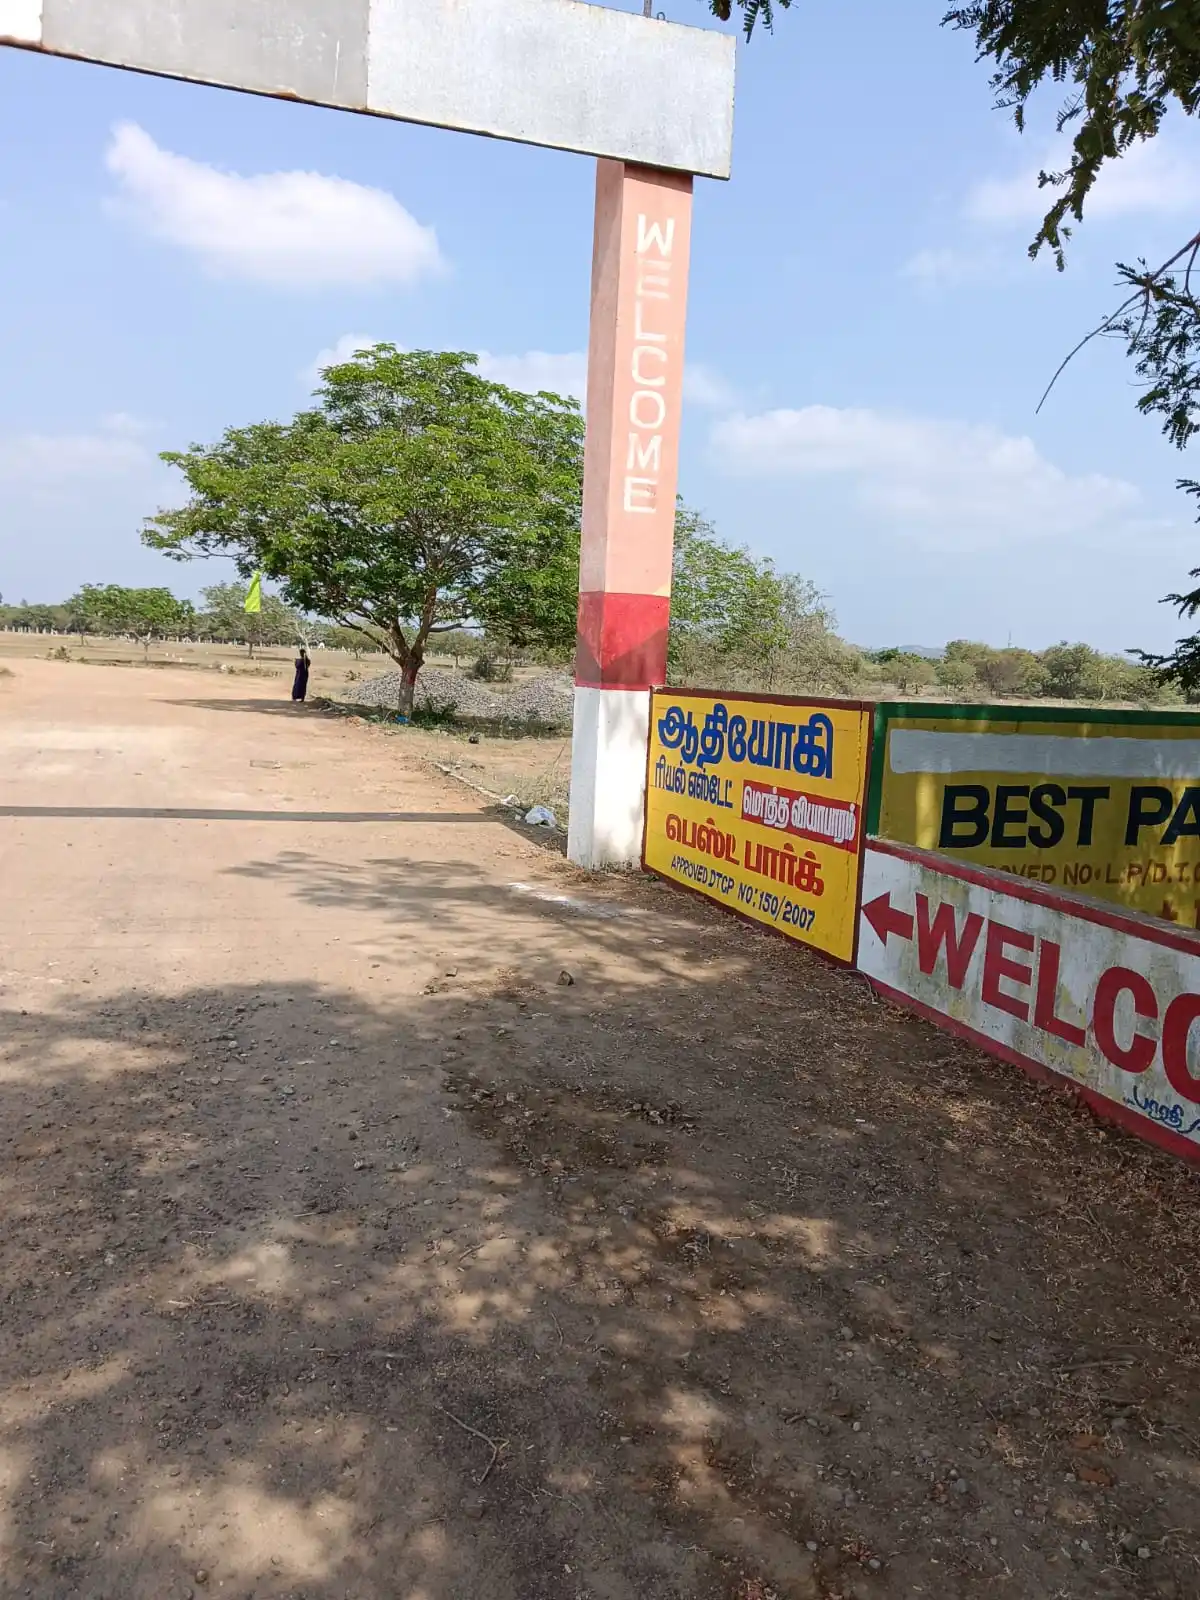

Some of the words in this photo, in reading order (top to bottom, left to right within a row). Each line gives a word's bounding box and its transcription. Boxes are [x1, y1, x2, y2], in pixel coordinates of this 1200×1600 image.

[623, 213, 675, 514] WELCOME
[658, 703, 834, 780] ஆதியோகி
[743, 785, 790, 829] மொத்த
[791, 795, 856, 844] வியாபாரம்
[938, 783, 1110, 849] BEST
[670, 855, 708, 885] APPROVED
[708, 868, 735, 896] DTCP
[744, 842, 825, 897] பார்க்
